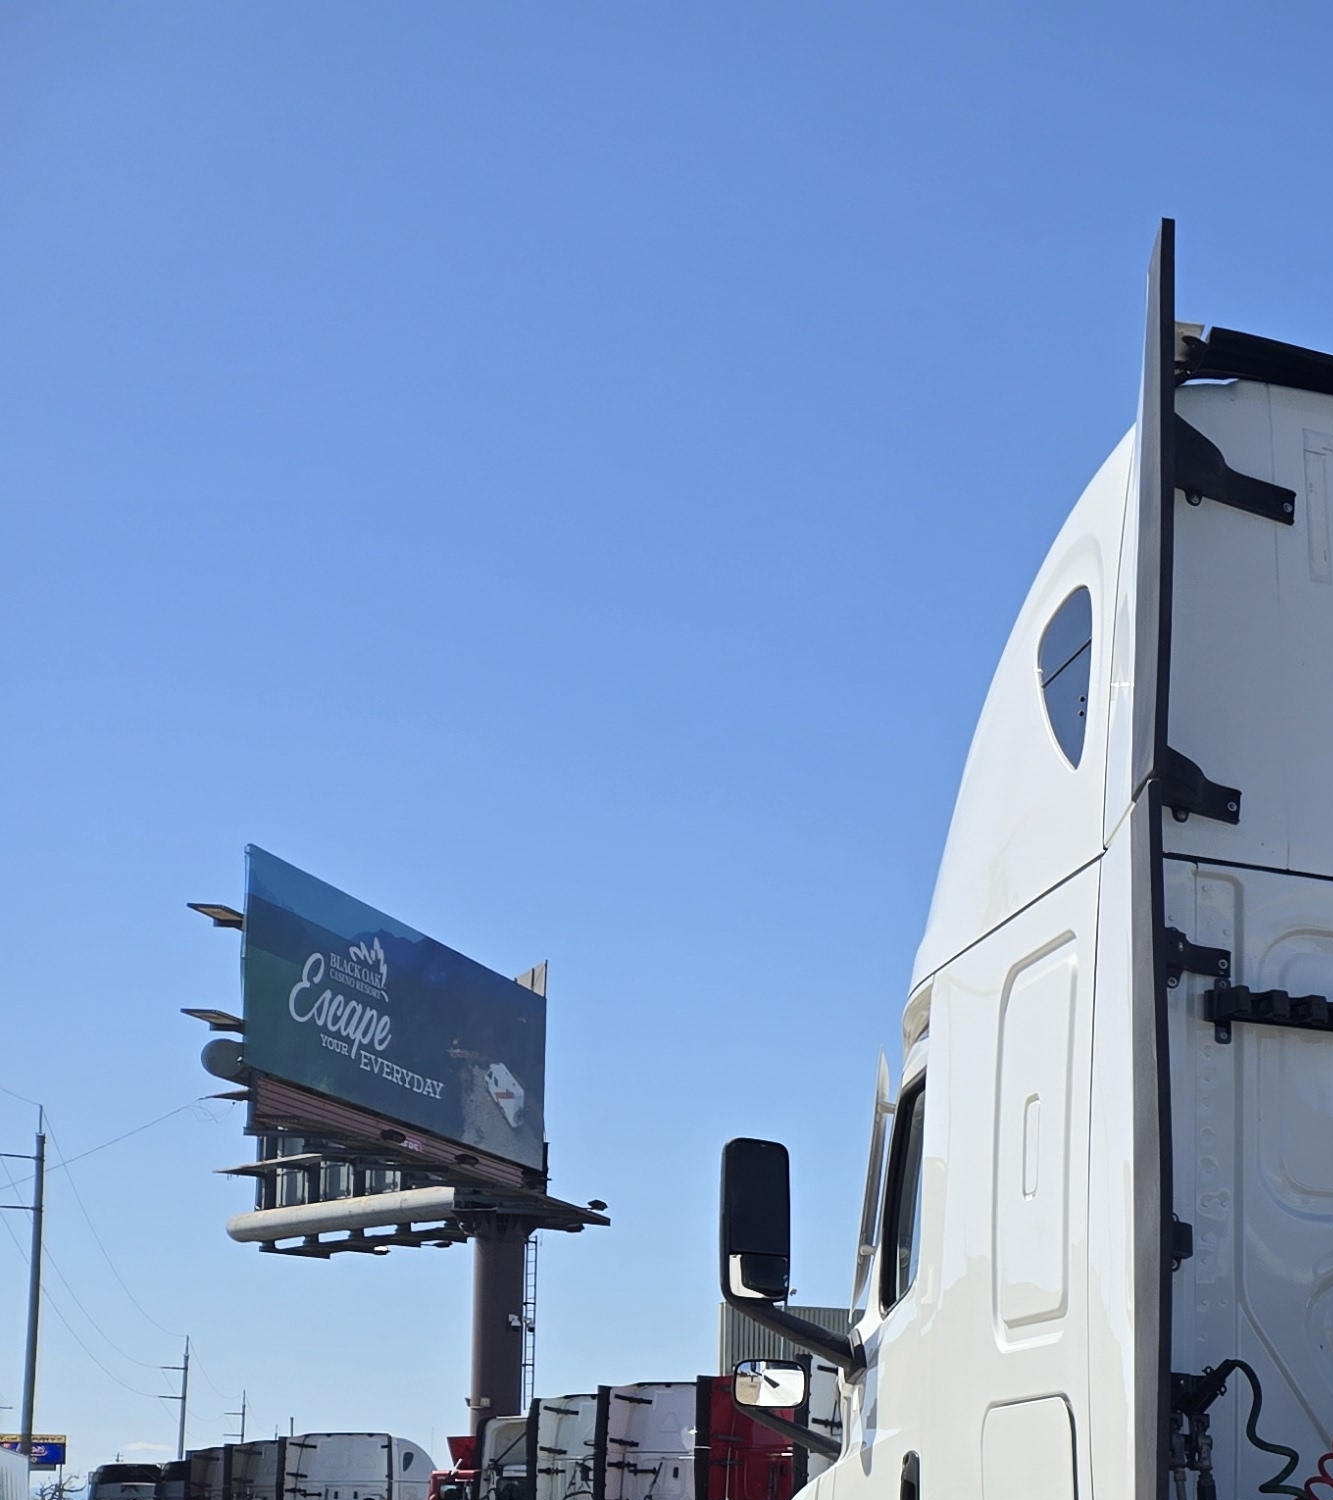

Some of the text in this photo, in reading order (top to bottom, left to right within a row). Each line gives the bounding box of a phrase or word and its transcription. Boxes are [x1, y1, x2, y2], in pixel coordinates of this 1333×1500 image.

[330, 953, 382, 988] BLACK OAK
[330, 969, 382, 999] CASINO RESORT
[289, 952, 392, 1059] Escape
[320, 1033, 445, 1099] YOUR EVERYDAY
